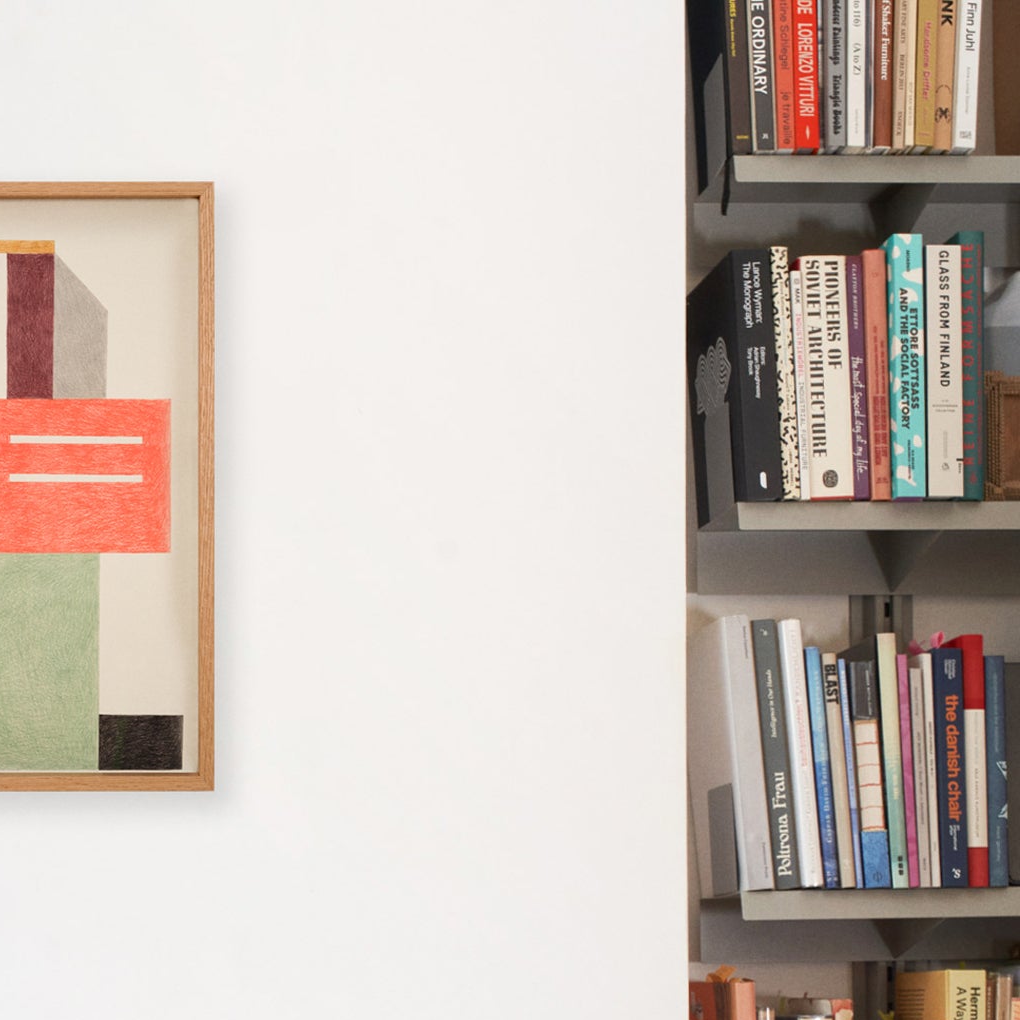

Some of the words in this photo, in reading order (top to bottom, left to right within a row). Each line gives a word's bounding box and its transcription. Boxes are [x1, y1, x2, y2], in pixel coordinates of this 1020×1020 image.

[881, 6, 890, 36] Shaker
[966, 2, 977, 26] Finn
[752, 16, 767, 94] ORDINARY
[778, 25, 790, 70] Schlegel
[798, 23, 814, 73] LORENZO
[829, 27, 842, 65] Paintings
[852, 43, 861, 54] (A
[881, 38, 890, 80] Furniture
[923, 22, 932, 68] Handsome
[965, 28, 976, 52] Juhl
[852, 65, 861, 76] Z)
[853, 55, 860, 64] to
[781, 92, 790, 101] je
[798, 76, 814, 117] VITTURI
[829, 75, 842, 107] Triangle
[922, 70, 930, 100] Drifter
[782, 104, 792, 144] travaille
[832, 110, 842, 135] Books
[742, 262, 751, 278] The
[752, 262, 762, 288] Lance
[938, 250, 950, 290] GLASS
[742, 280, 753, 328] Monograph
[752, 289, 763, 323] Wyman:
[805, 260, 821, 319] SOVIET
[824, 260, 841, 342] PIONEERS
[900, 288, 908, 312] AND
[900, 314, 908, 335] THE
[910, 308, 918, 350] ETTORE
[939, 295, 950, 329] FROM
[961, 243, 974, 381] FORMSACHE
[828, 348, 842, 370] OF
[851, 356, 863, 368] the
[900, 338, 910, 378] SOCIAL
[940, 334, 950, 388] FINLAND
[808, 325, 827, 458] ARCHITECTURE
[852, 370, 865, 388] most
[910, 353, 920, 410] SOTTSASS
[798, 382, 806, 426] INDUSTRIAL
[901, 380, 910, 430] FACTORY
[852, 421, 864, 434] day
[856, 436, 867, 444] of
[962, 399, 975, 466] REINE
[800, 430, 808, 470] FURNITURE
[824, 664, 838, 704] BLAST
[769, 707, 778, 738] Intelligence
[946, 694, 959, 721] the
[946, 725, 960, 778] danish
[772, 772, 787, 810] Frau
[948, 781, 962, 822] chair
[776, 814, 792, 876] Poltrona
[956, 986, 967, 996] A
